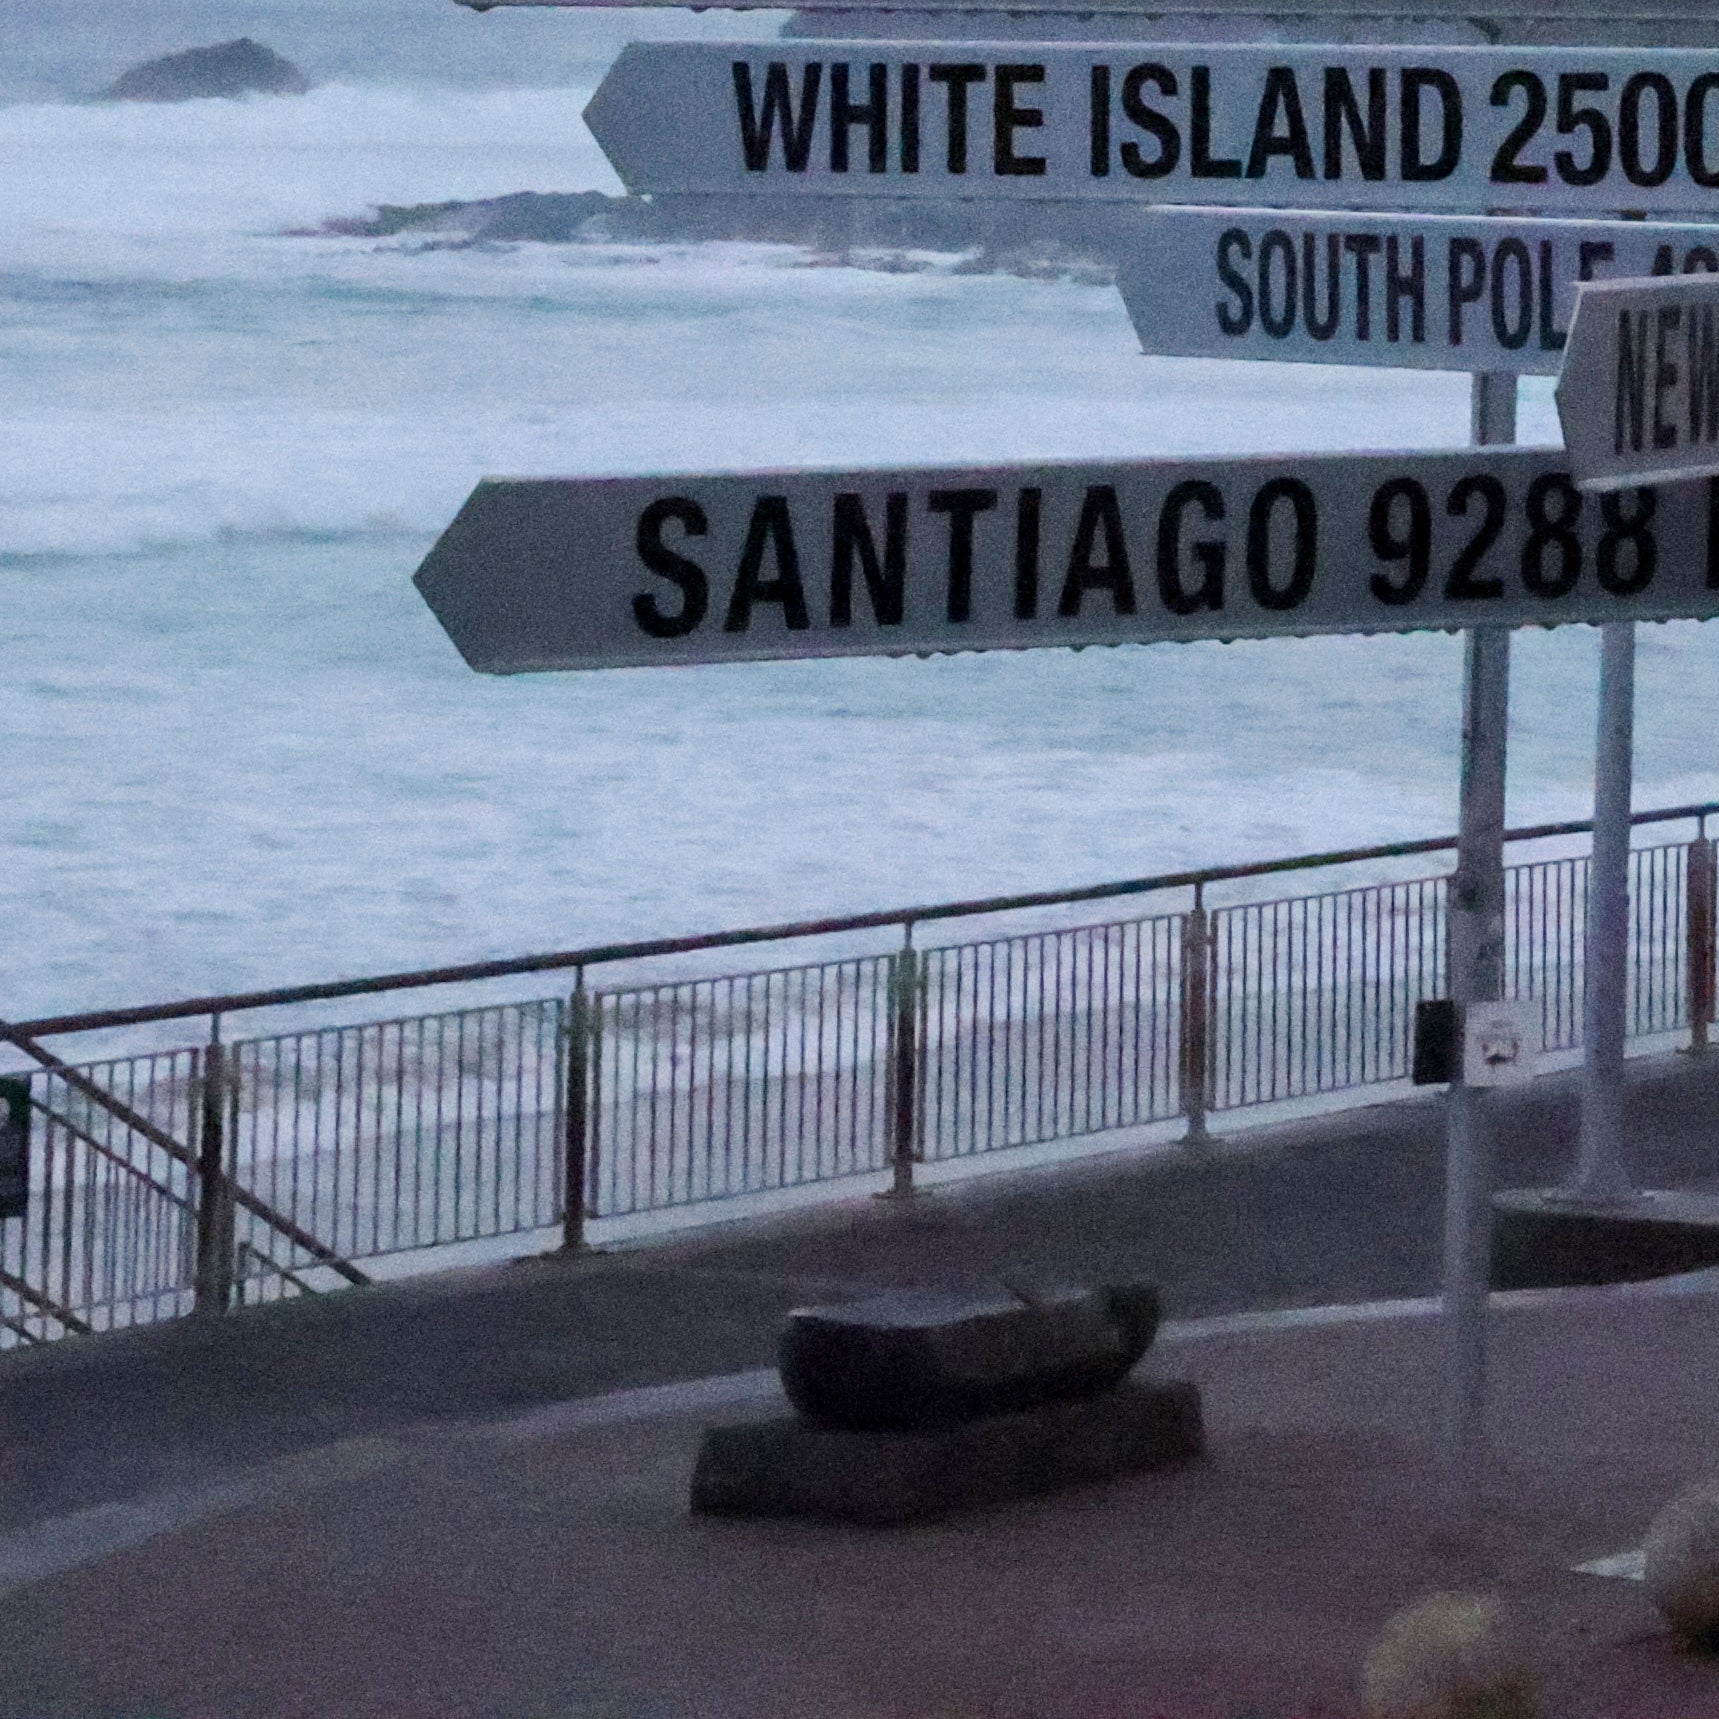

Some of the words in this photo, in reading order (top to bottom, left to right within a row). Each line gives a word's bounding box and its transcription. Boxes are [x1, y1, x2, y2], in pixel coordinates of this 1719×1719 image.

[730, 60, 1047, 177] WHITE
[1090, 64, 1462, 183] ISLAND
[1215, 227, 1426, 346] SOUTH
[631, 474, 1317, 639] SANTIAGO
[1369, 473, 1657, 606] 9288
